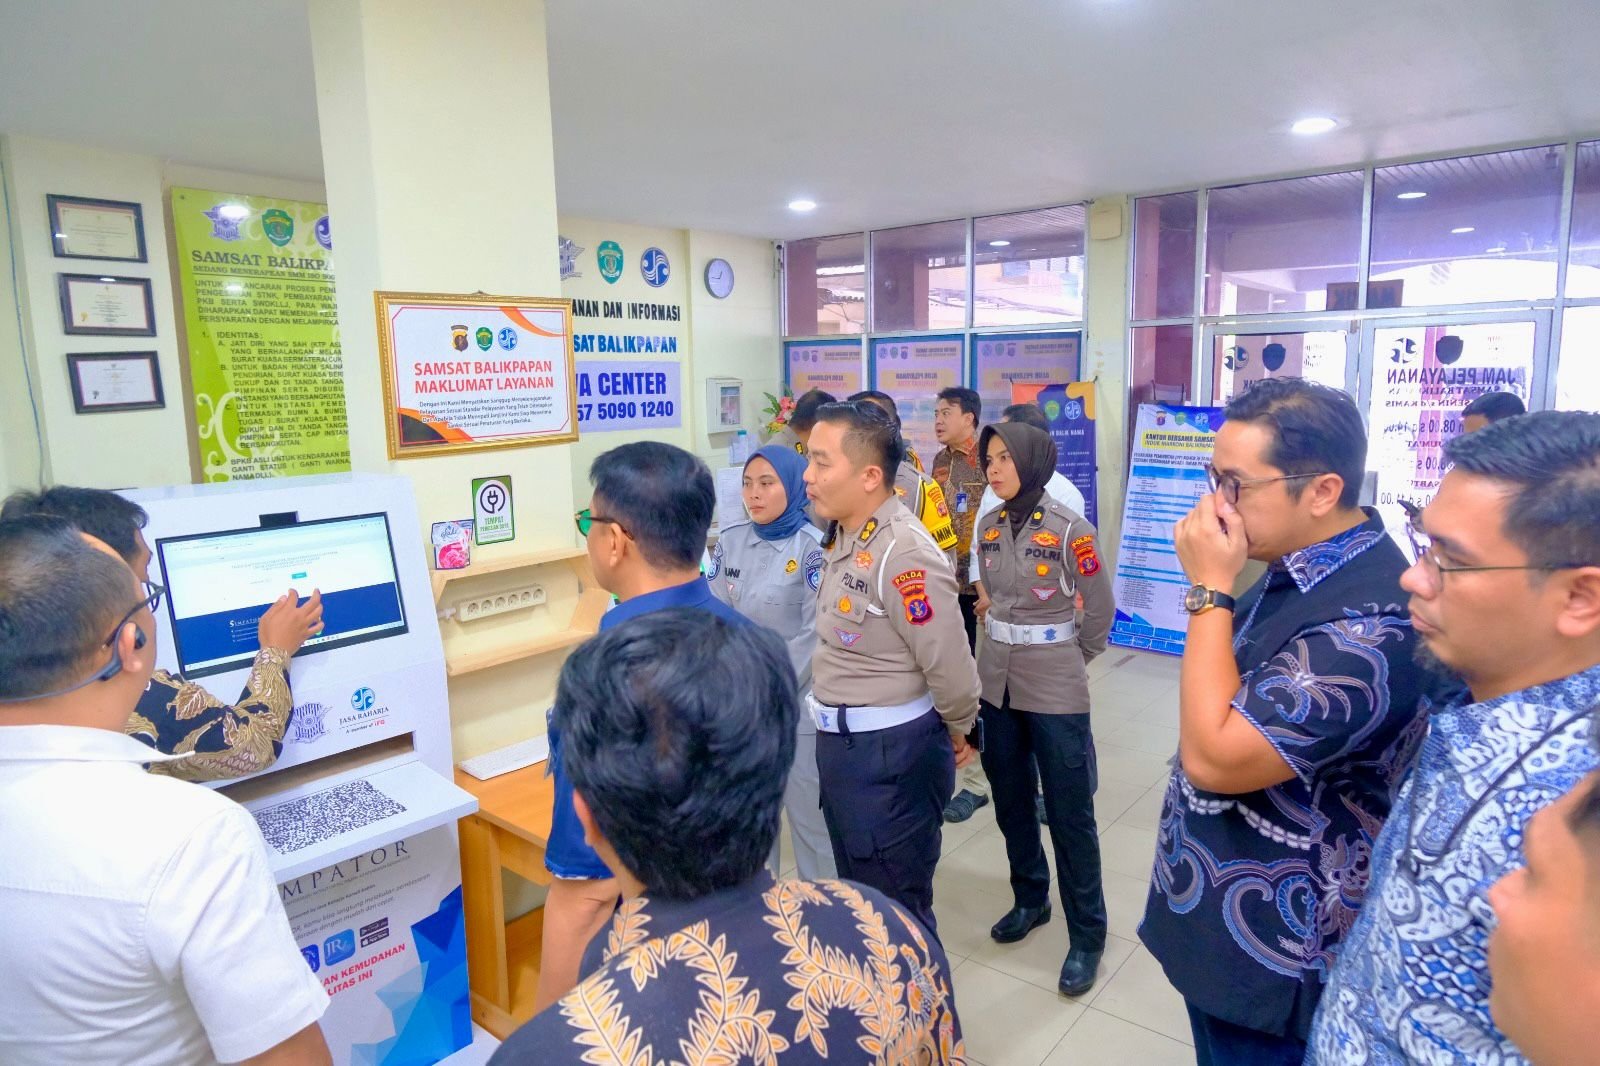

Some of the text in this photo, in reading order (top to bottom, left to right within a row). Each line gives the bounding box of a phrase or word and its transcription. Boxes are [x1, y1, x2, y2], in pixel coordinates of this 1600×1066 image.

[192, 250, 262, 266] SAMSAT
[286, 284, 316, 292] PROSES
[284, 293, 332, 301] PEMBAYARAN
[198, 306, 251, 315] DIHARAPKAN
[604, 301, 622, 318] DAN
[628, 302, 680, 322] INFORMASI
[598, 335, 677, 353] BALIKPAPAN
[414, 361, 552, 376] SAMSAT BALIKPAPAN
[415, 377, 554, 394] MAKLUMAT LAYANAN
[598, 372, 666, 396] CENTER
[598, 402, 637, 420] 5090
[640, 400, 674, 418] 1240
[1025, 548, 1060, 562] POLRI
[842, 572, 868, 594] POLRI
[894, 571, 922, 585] POLDA
[339, 706, 390, 726] JASA RAHARJA
[342, 944, 406, 978] KEMUDAHAN
[328, 970, 374, 996] LITAS INI
